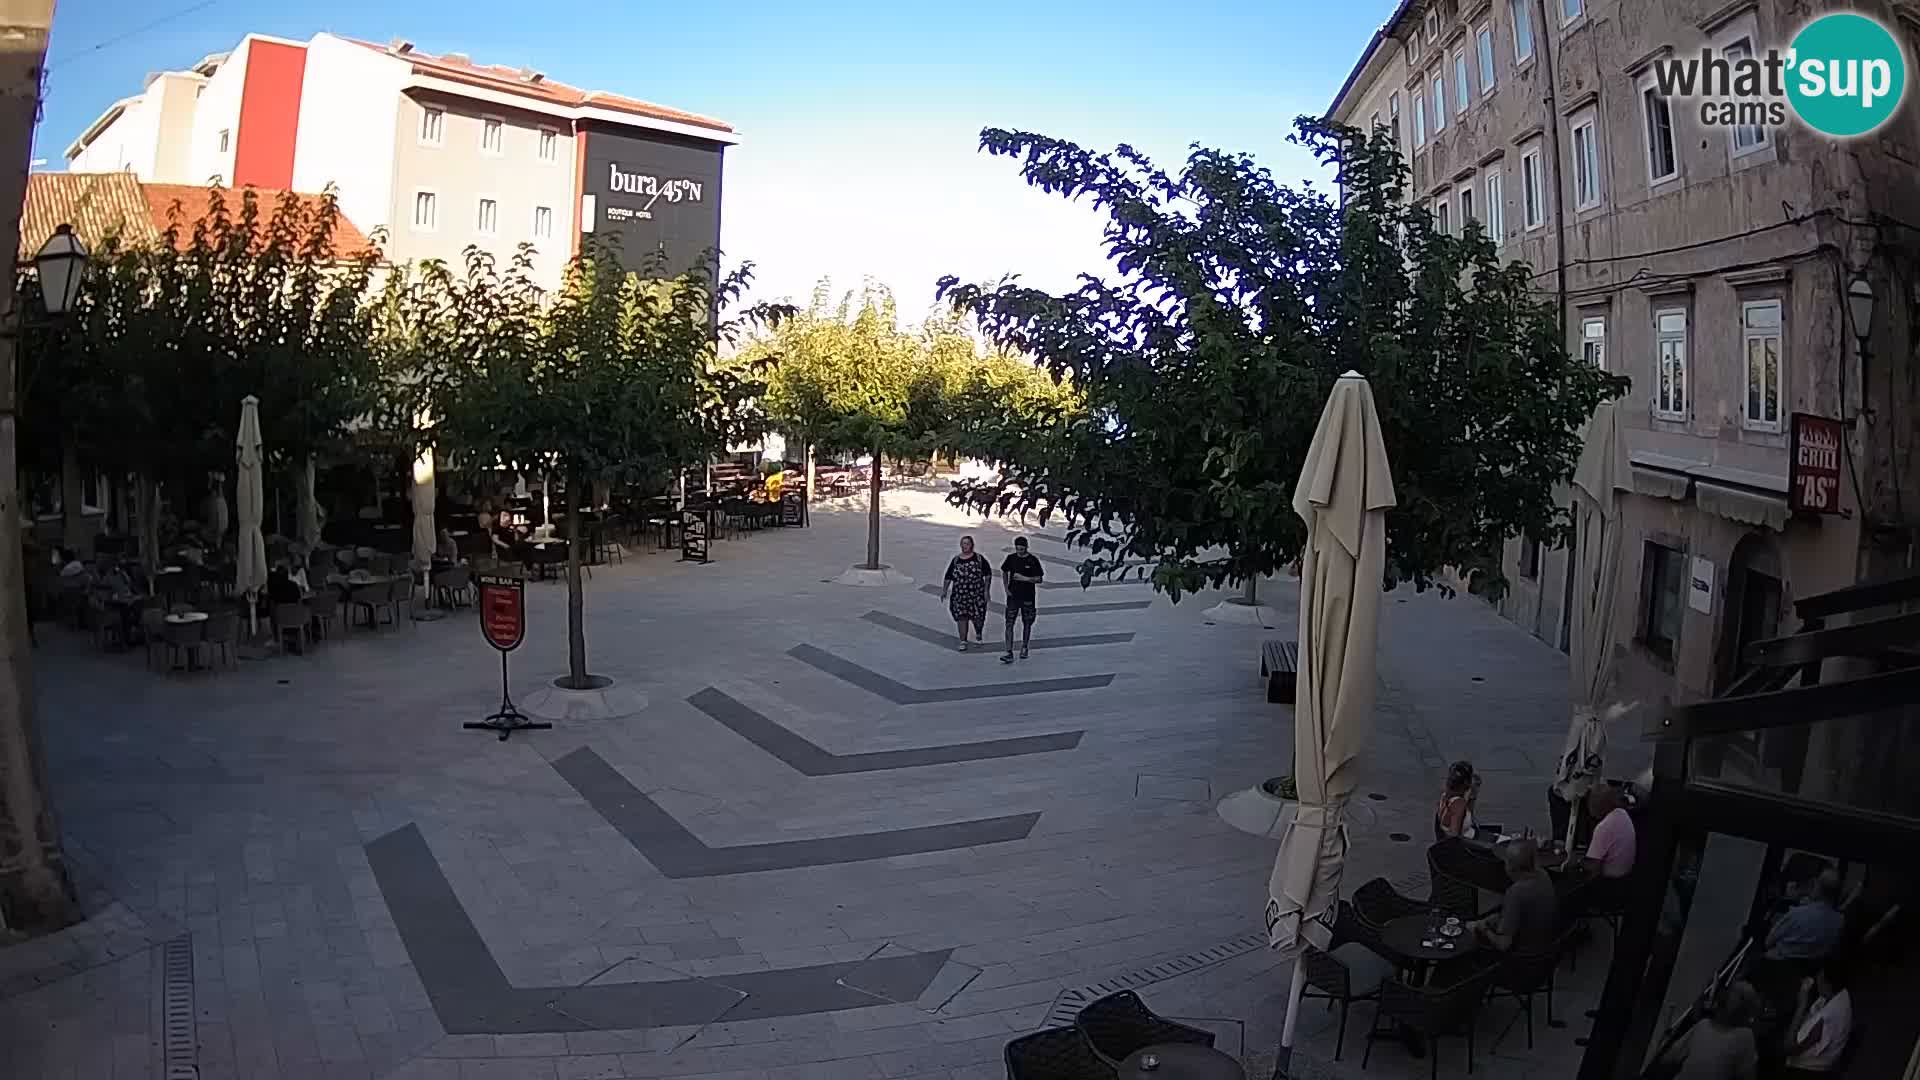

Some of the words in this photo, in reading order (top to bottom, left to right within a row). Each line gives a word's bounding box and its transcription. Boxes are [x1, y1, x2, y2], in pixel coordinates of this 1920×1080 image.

[608, 207, 633, 217] BOUTIQUE
[635, 211, 652, 219] HOTEL
[1798, 446, 1838, 471] GRILL
[499, 577, 513, 585] BAR
